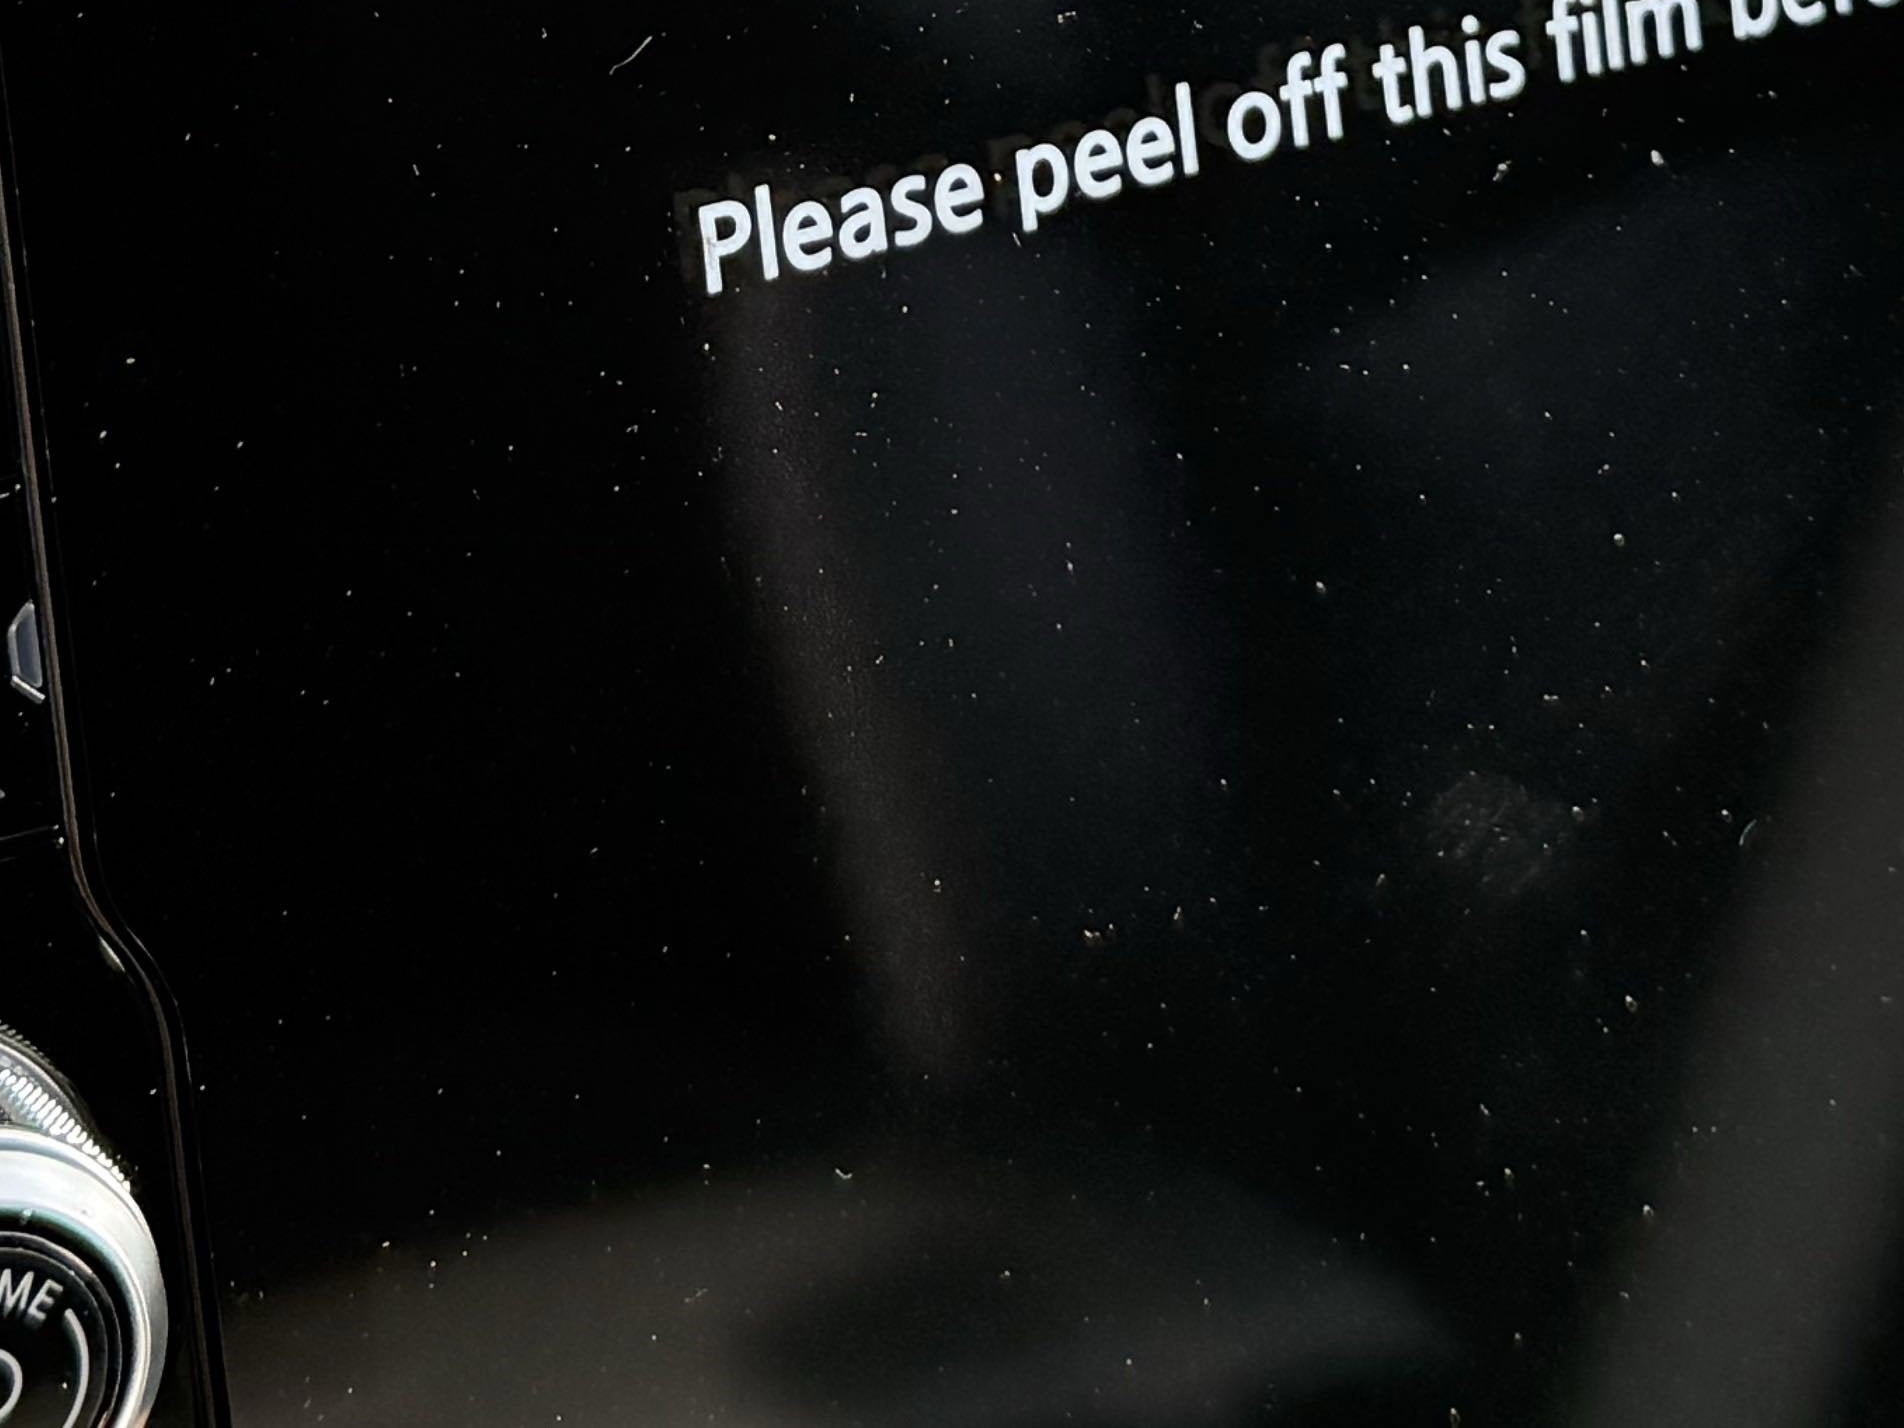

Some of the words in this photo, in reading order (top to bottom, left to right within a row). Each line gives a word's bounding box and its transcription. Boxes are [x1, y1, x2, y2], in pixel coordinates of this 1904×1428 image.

[697, 162, 986, 295] Please
[1014, 80, 1201, 234] peel
[1226, 41, 1350, 162] off
[1370, 12, 1527, 126] this
